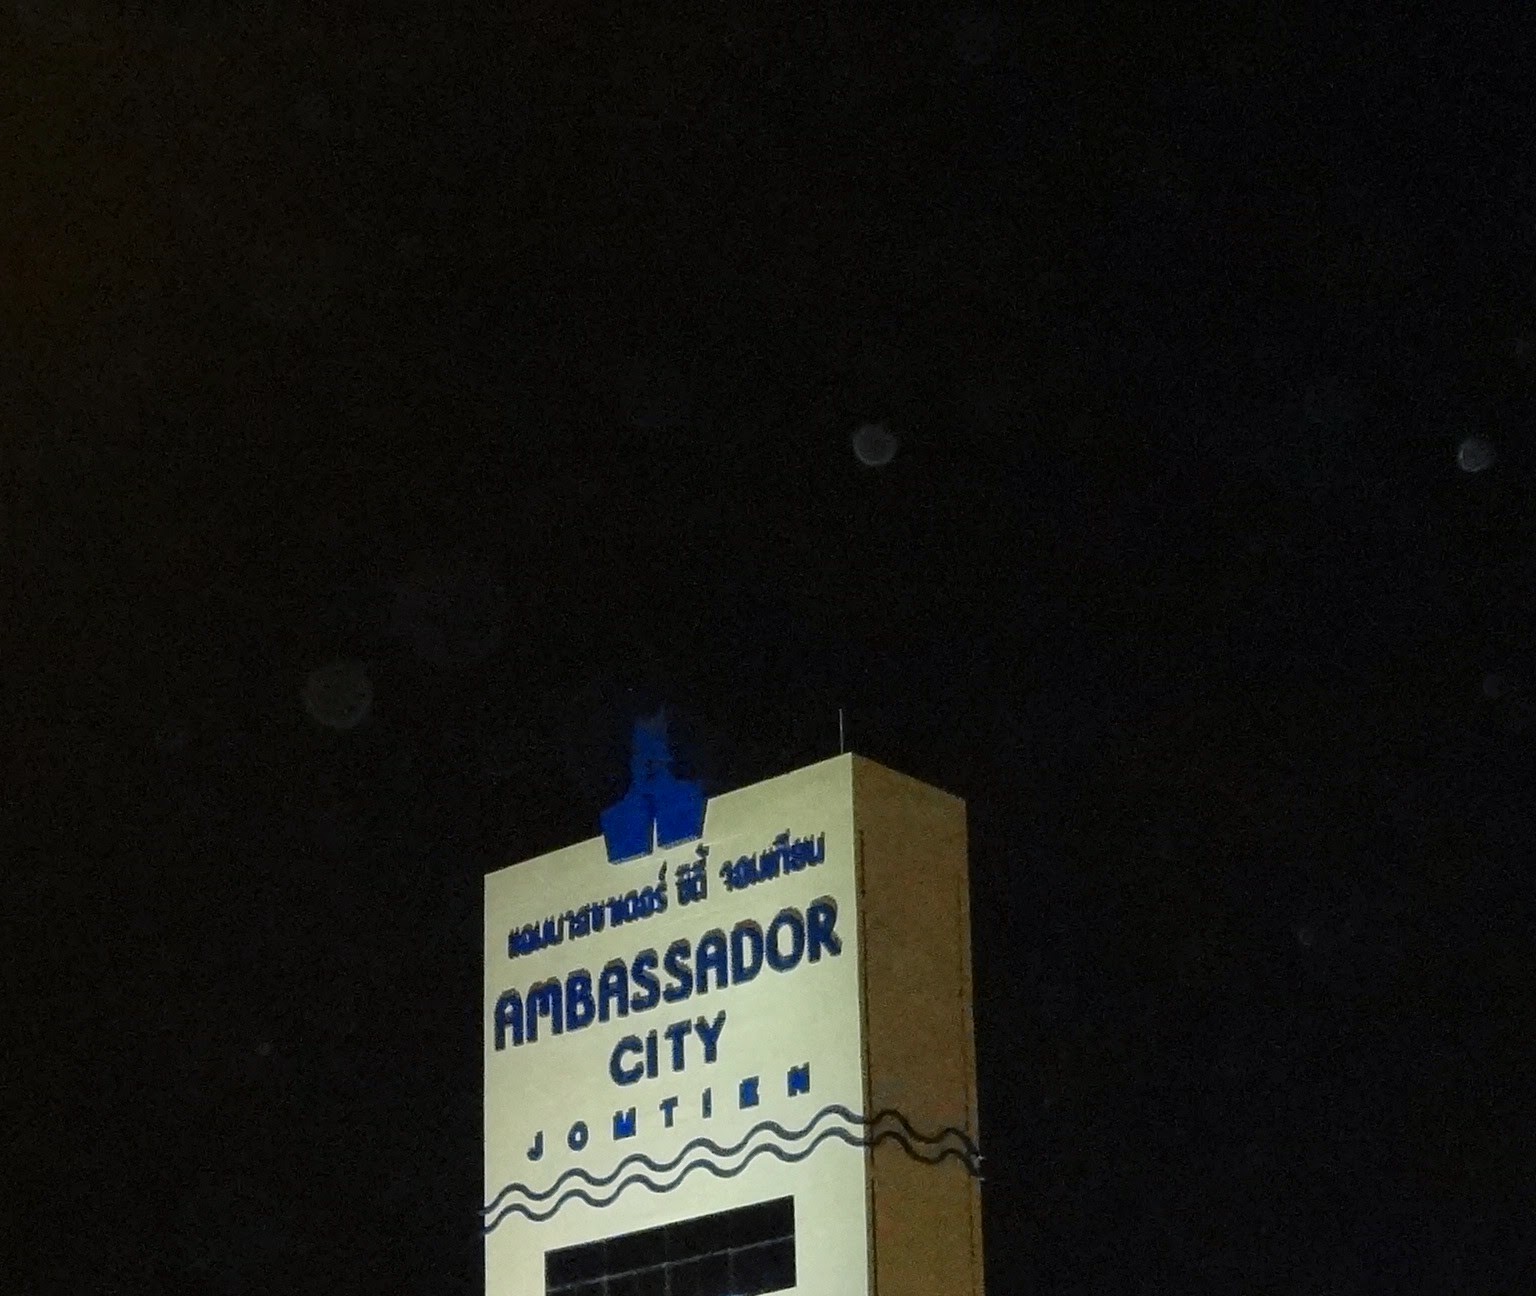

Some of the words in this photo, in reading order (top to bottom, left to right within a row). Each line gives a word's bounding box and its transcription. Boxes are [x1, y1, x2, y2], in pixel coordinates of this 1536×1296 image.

[494, 896, 843, 1051] AMBASSADOR
[609, 1009, 728, 1087] CITY
[526, 1062, 811, 1162] JOMTIEN
